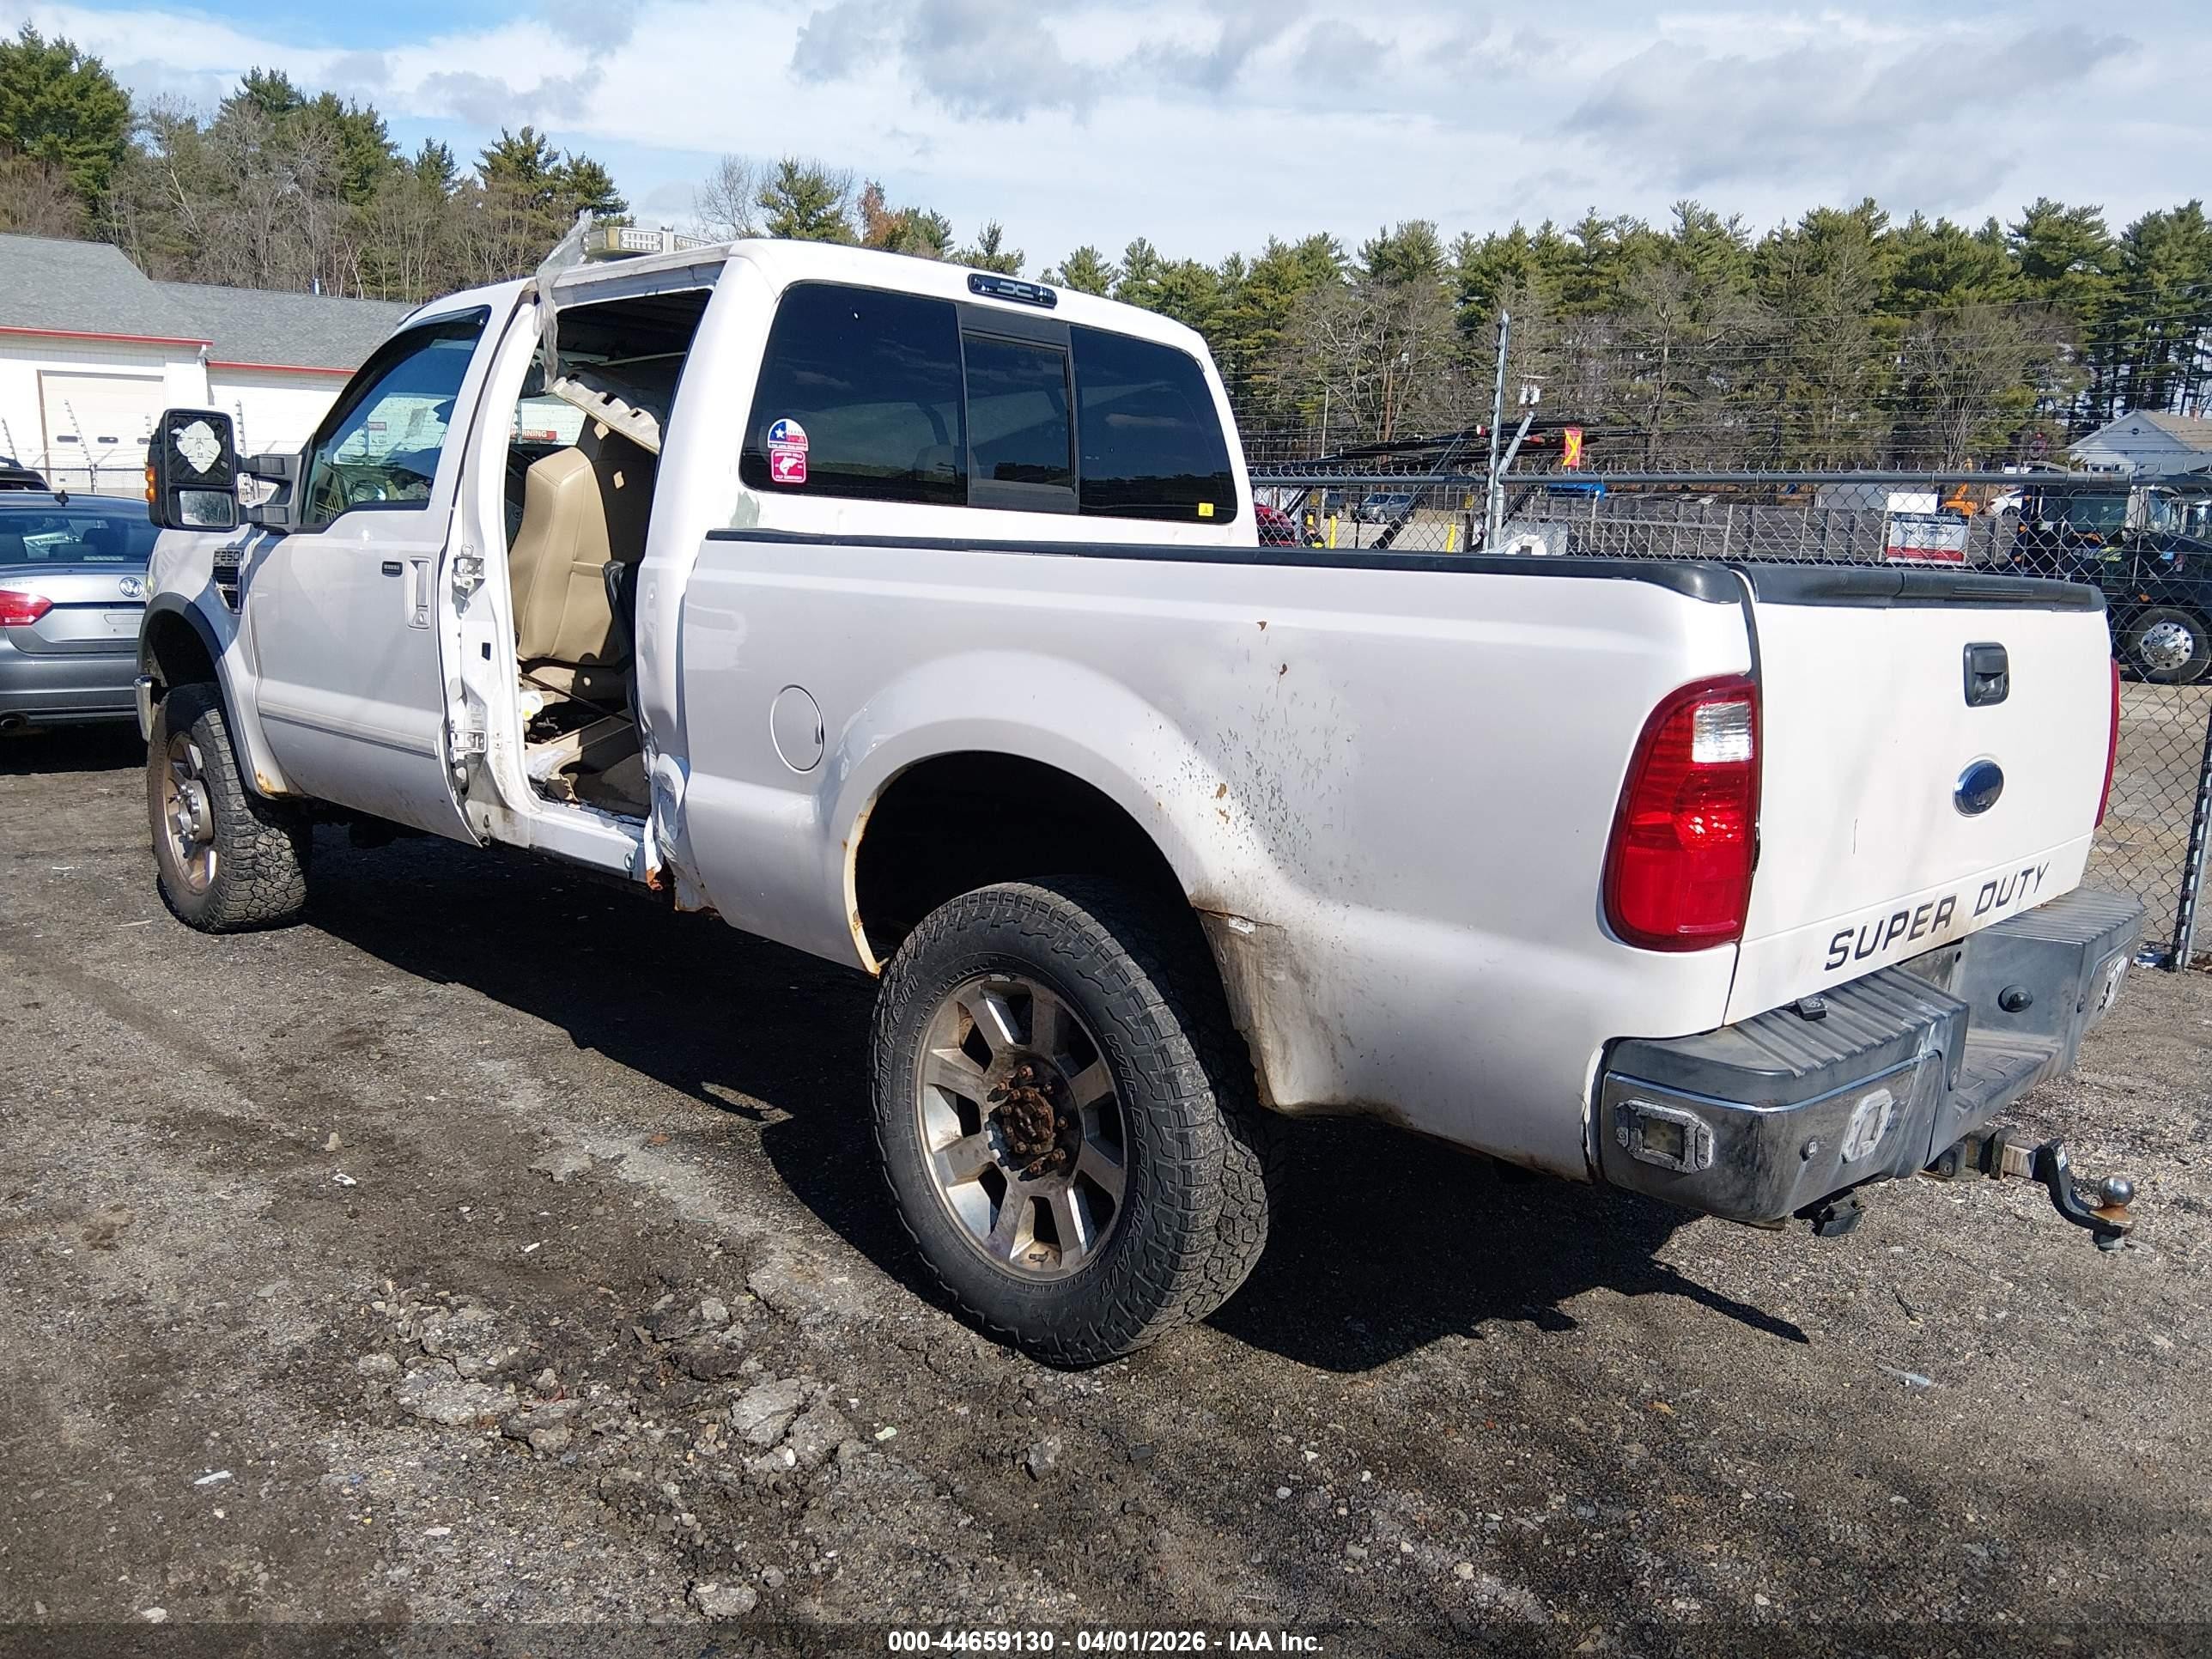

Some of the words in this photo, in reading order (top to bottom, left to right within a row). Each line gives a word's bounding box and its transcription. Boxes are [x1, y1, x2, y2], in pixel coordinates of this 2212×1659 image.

[1824, 895, 1958, 971] SUPER
[1972, 860, 2051, 917] DUTY
[1103, 1033, 1149, 1250] WILDPEAK
